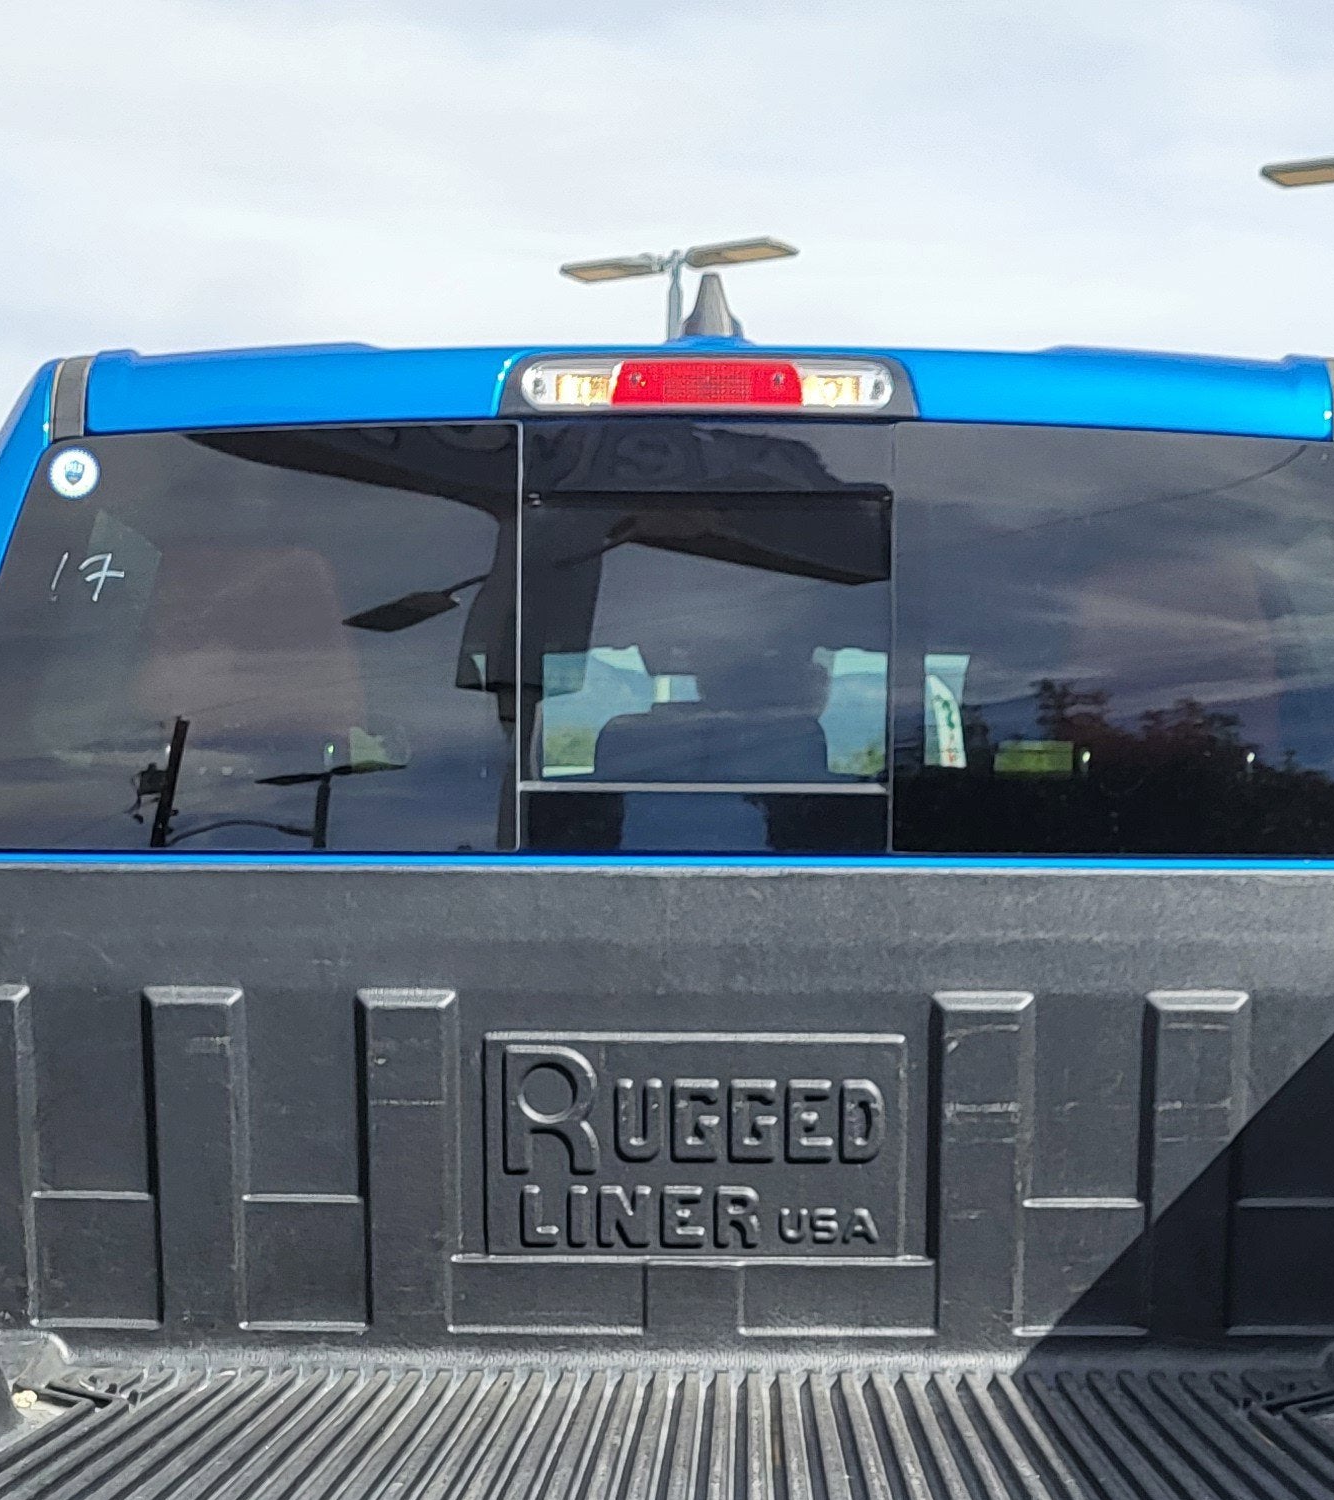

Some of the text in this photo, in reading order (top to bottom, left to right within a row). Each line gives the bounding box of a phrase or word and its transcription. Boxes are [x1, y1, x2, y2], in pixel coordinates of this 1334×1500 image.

[502, 1044, 886, 1175] RUGGED
[519, 1184, 879, 1248] LINER USA
